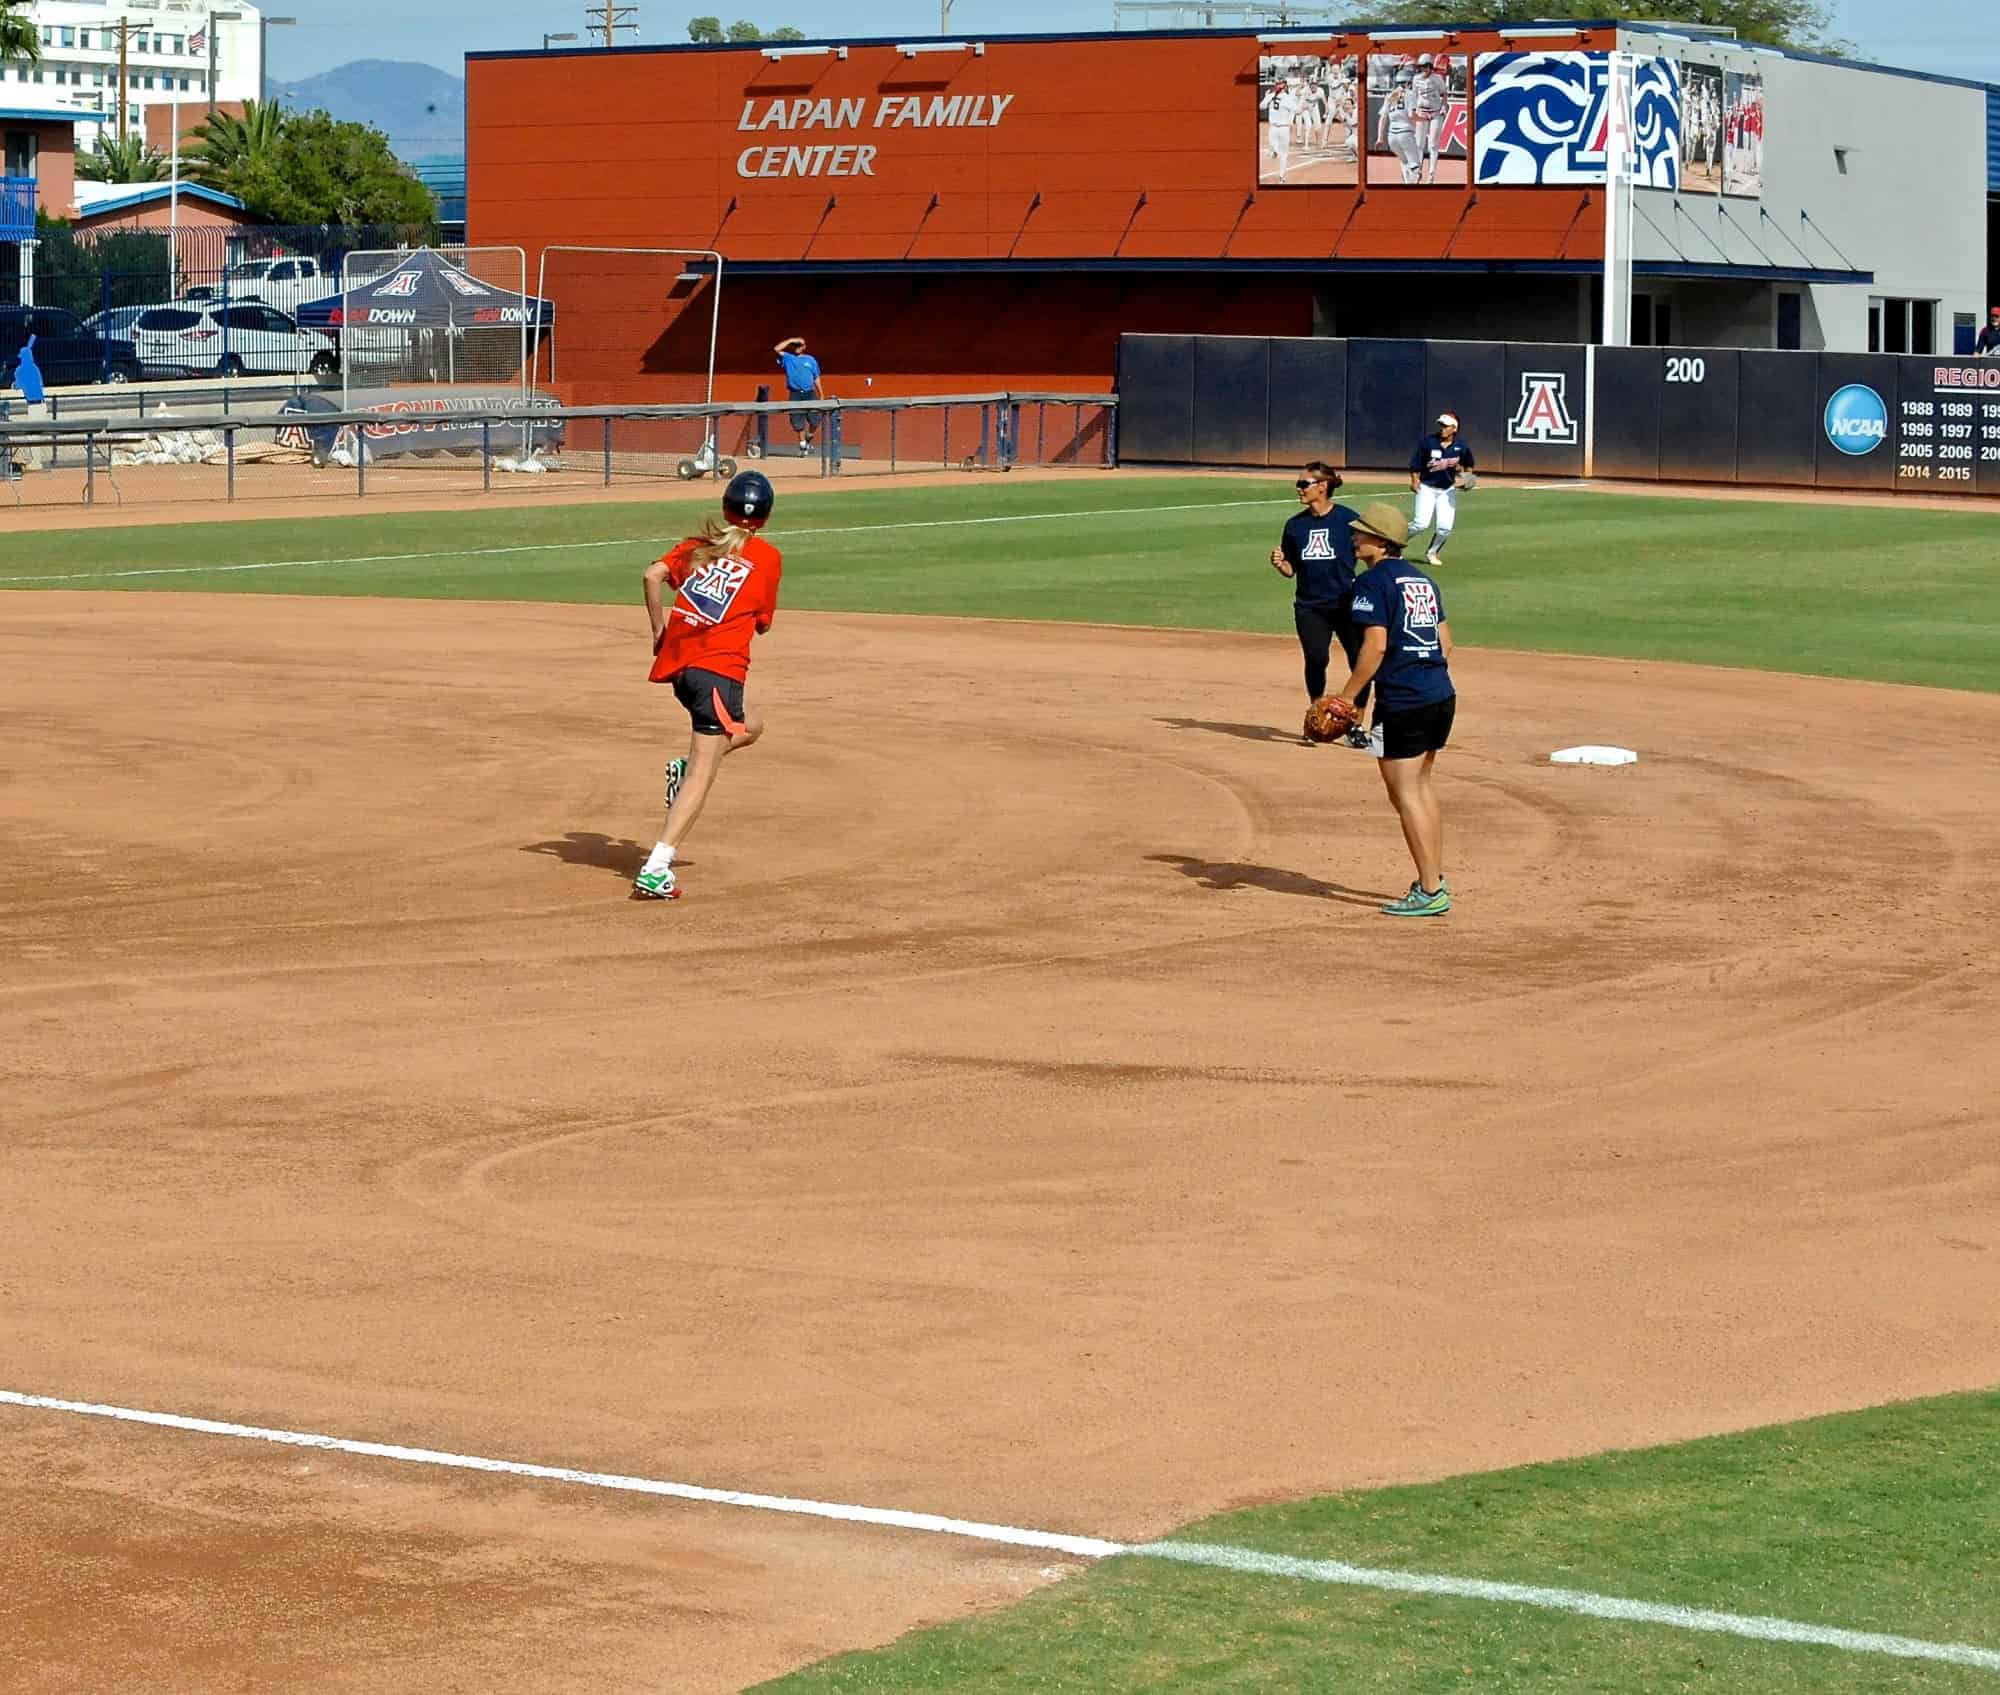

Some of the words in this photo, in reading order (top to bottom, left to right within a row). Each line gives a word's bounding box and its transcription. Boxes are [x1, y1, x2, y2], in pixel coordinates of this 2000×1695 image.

[737, 98, 865, 131] LAPAN
[872, 94, 1015, 128] FAMILY
[736, 145, 877, 178] CENTER
[372, 270, 423, 297] A
[1665, 358, 1705, 382] 200
[1934, 367, 2000, 388] REGIO
[1507, 372, 1578, 444] A
[1901, 401, 1934, 416] 1988
[1940, 403, 1973, 417] 1989
[1830, 418, 1886, 438] NCAA
[1901, 422, 1933, 436] 1996
[1940, 424, 1972, 438] 1997
[1900, 443, 1933, 458] 2005
[1939, 445, 1972, 459] 2006
[1900, 464, 1930, 479] 2014
[1938, 466, 1970, 480] 2015
[1302, 529, 1336, 560] A
[691, 567, 730, 605] A
[1411, 593, 1436, 628] A
